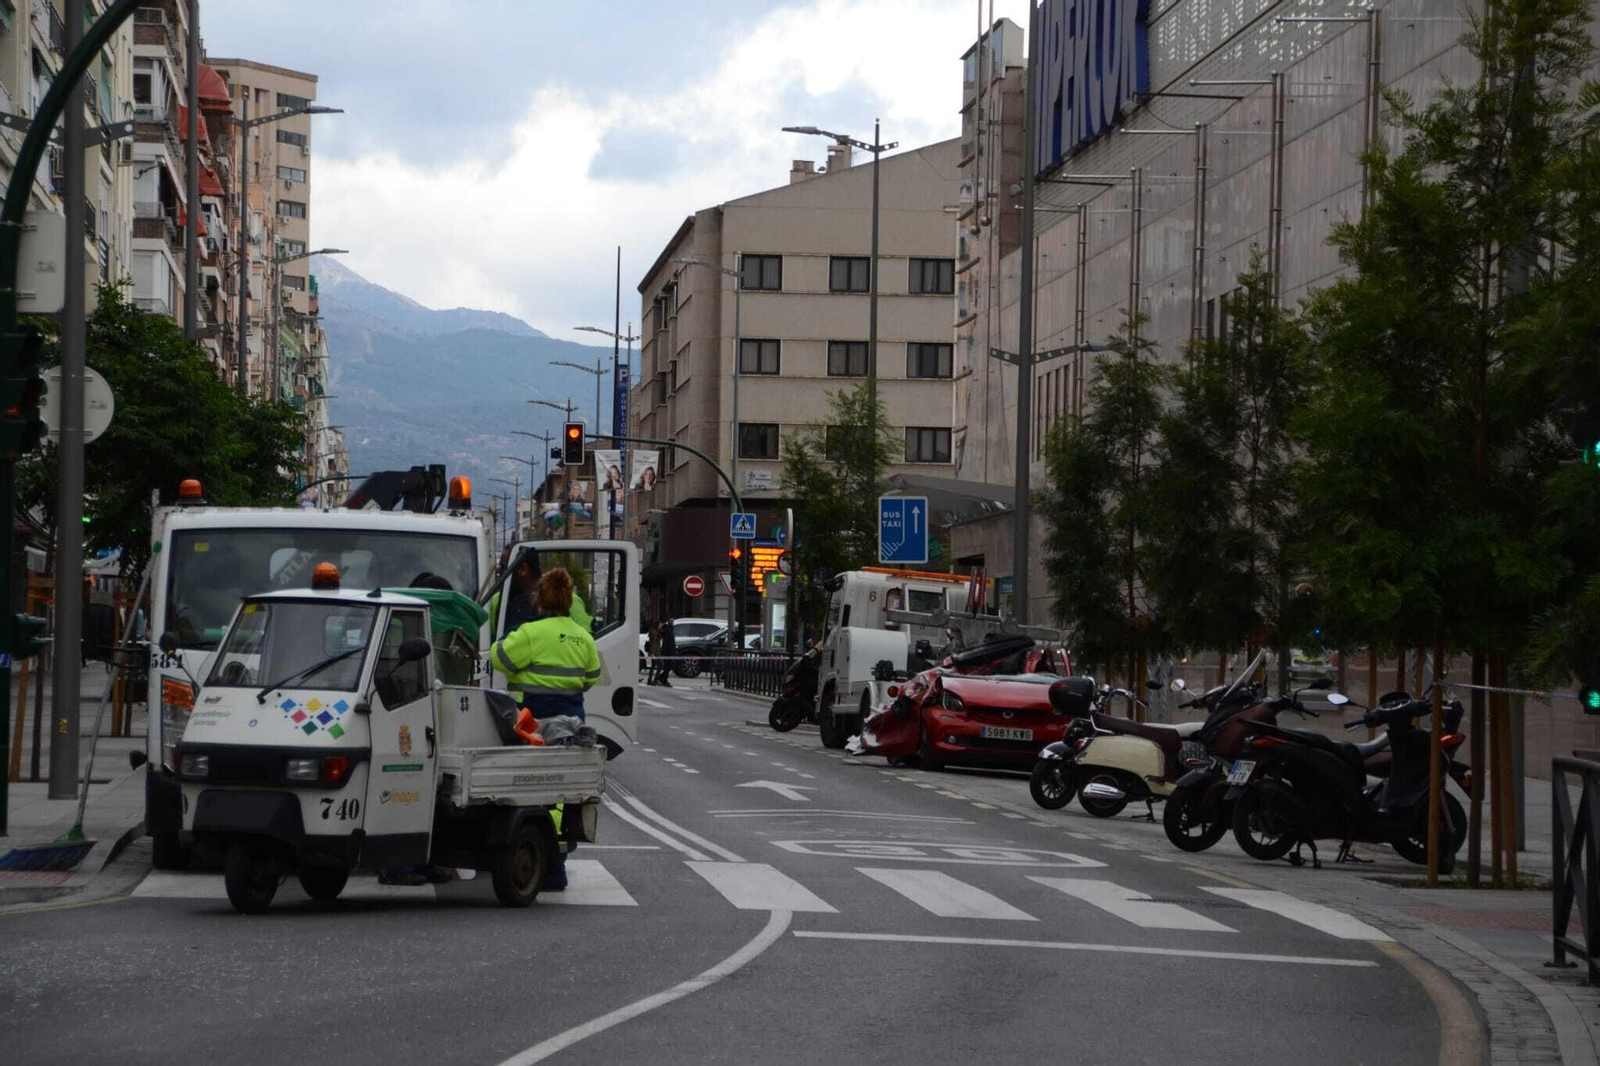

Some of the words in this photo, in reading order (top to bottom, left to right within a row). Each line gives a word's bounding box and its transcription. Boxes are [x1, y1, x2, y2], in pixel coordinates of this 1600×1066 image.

[882, 520, 901, 528] TAXI
[869, 591, 877, 602] 6
[987, 727, 1011, 738] 5981
[320, 798, 360, 821] 740
